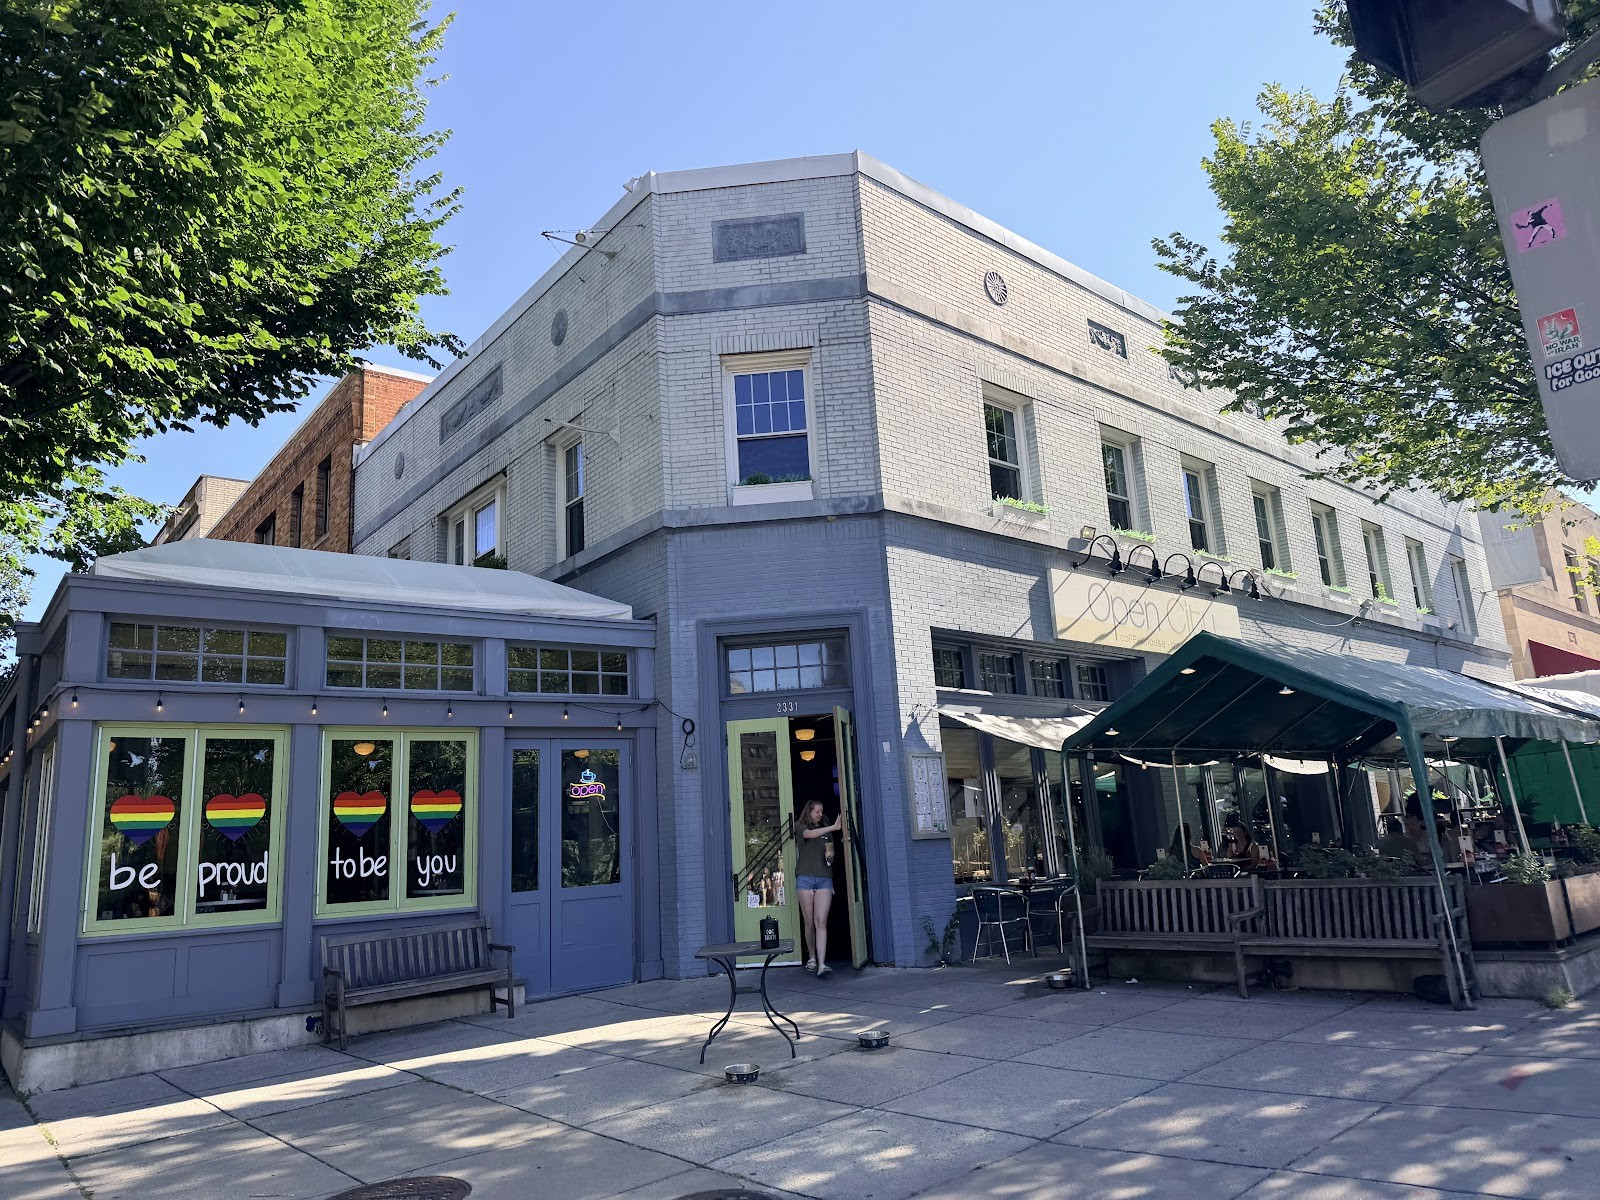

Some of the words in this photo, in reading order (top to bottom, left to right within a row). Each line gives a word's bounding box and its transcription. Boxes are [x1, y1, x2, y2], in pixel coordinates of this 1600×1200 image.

[1546, 343, 1558, 351] NO
[1560, 337, 1580, 345] WAR
[1555, 343, 1579, 354] IRAN
[1545, 358, 1573, 379] ICE
[1551, 376, 1573, 391] for
[1574, 367, 1600, 383] Goo
[1087, 582, 1161, 641] Open
[776, 701, 799, 713] 2331
[571, 784, 603, 797] open
[109, 852, 161, 891] be
[198, 850, 268, 898] proud
[416, 854, 456, 888] you
